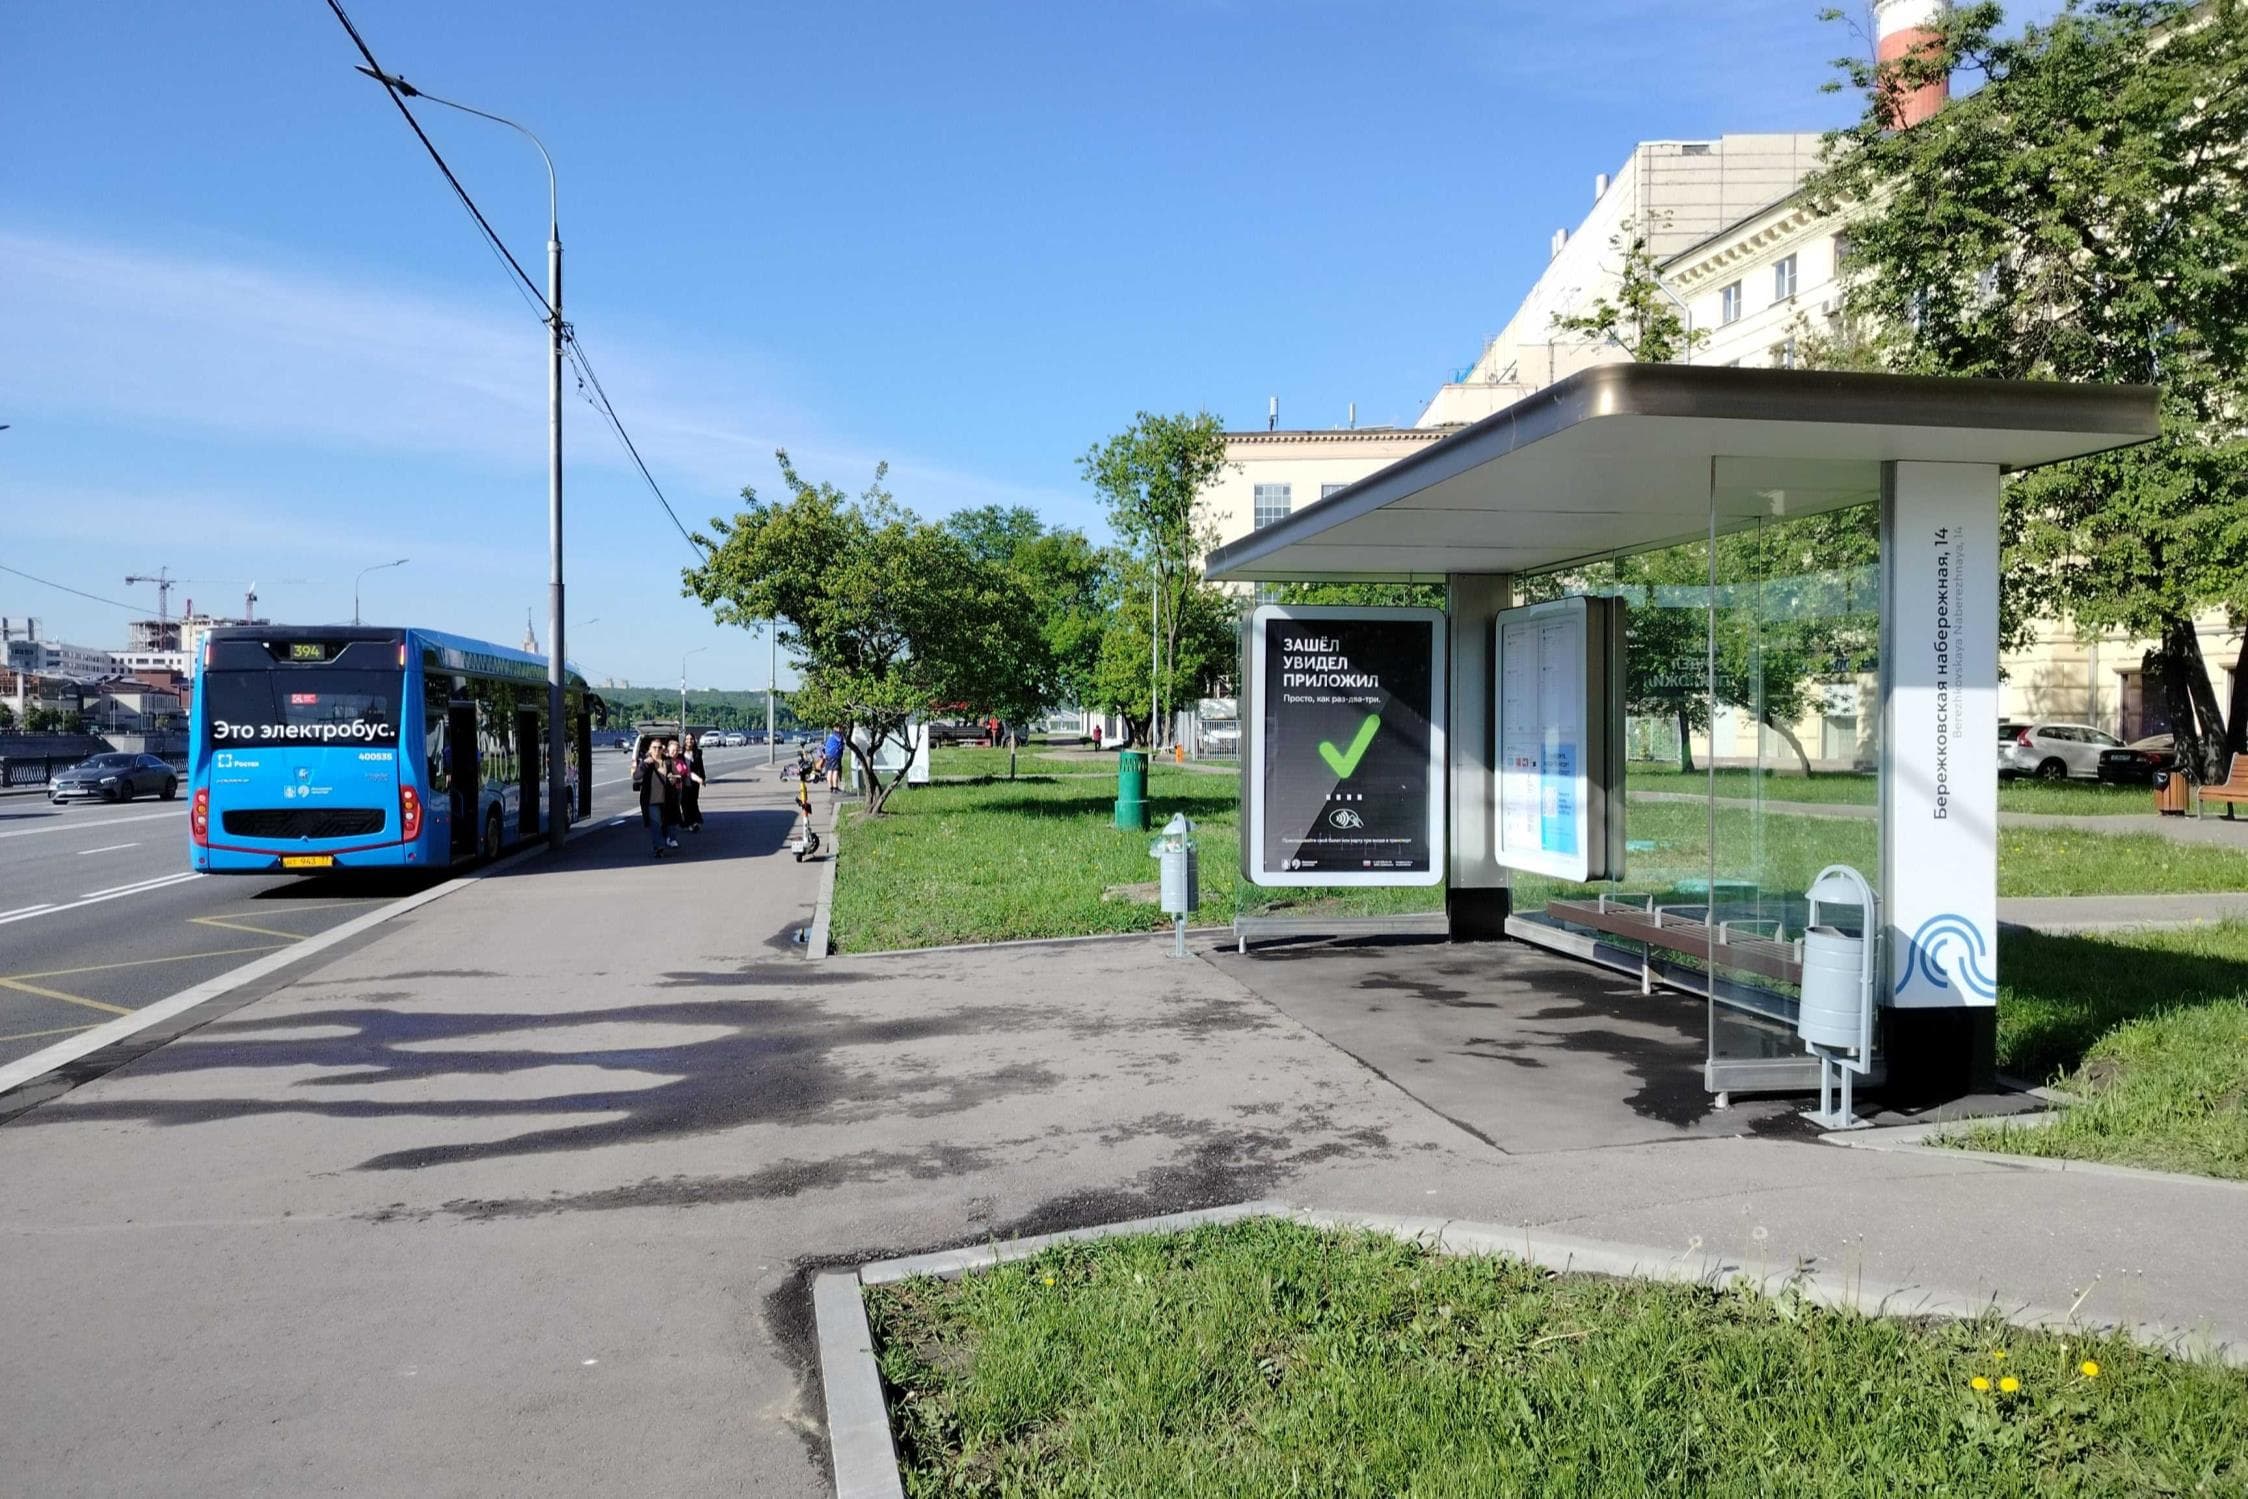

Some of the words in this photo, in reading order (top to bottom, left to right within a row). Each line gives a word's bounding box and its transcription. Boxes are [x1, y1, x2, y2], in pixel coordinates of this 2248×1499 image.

[1934, 527, 1948, 547] 14
[1953, 526, 1963, 539] 14
[1953, 542, 1965, 635] Naberezhnaya,
[1934, 552, 1951, 675] набережная,
[294, 644, 320, 657] 394
[1283, 635, 1340, 652] ЗАШЁЛ
[1283, 655, 1348, 672] УВИДЕЛ
[1283, 673, 1379, 688] ПРИЛОЖИЛ
[1953, 638, 1964, 738] Berezhkovskaya
[1283, 693, 1315, 704] Просто,
[1316, 695, 1330, 703] как
[1331, 695, 1381, 704] раз-два-три.
[213, 720, 254, 740] Это
[260, 719, 395, 742] электробус.
[1933, 681, 1950, 820] Бережковская
